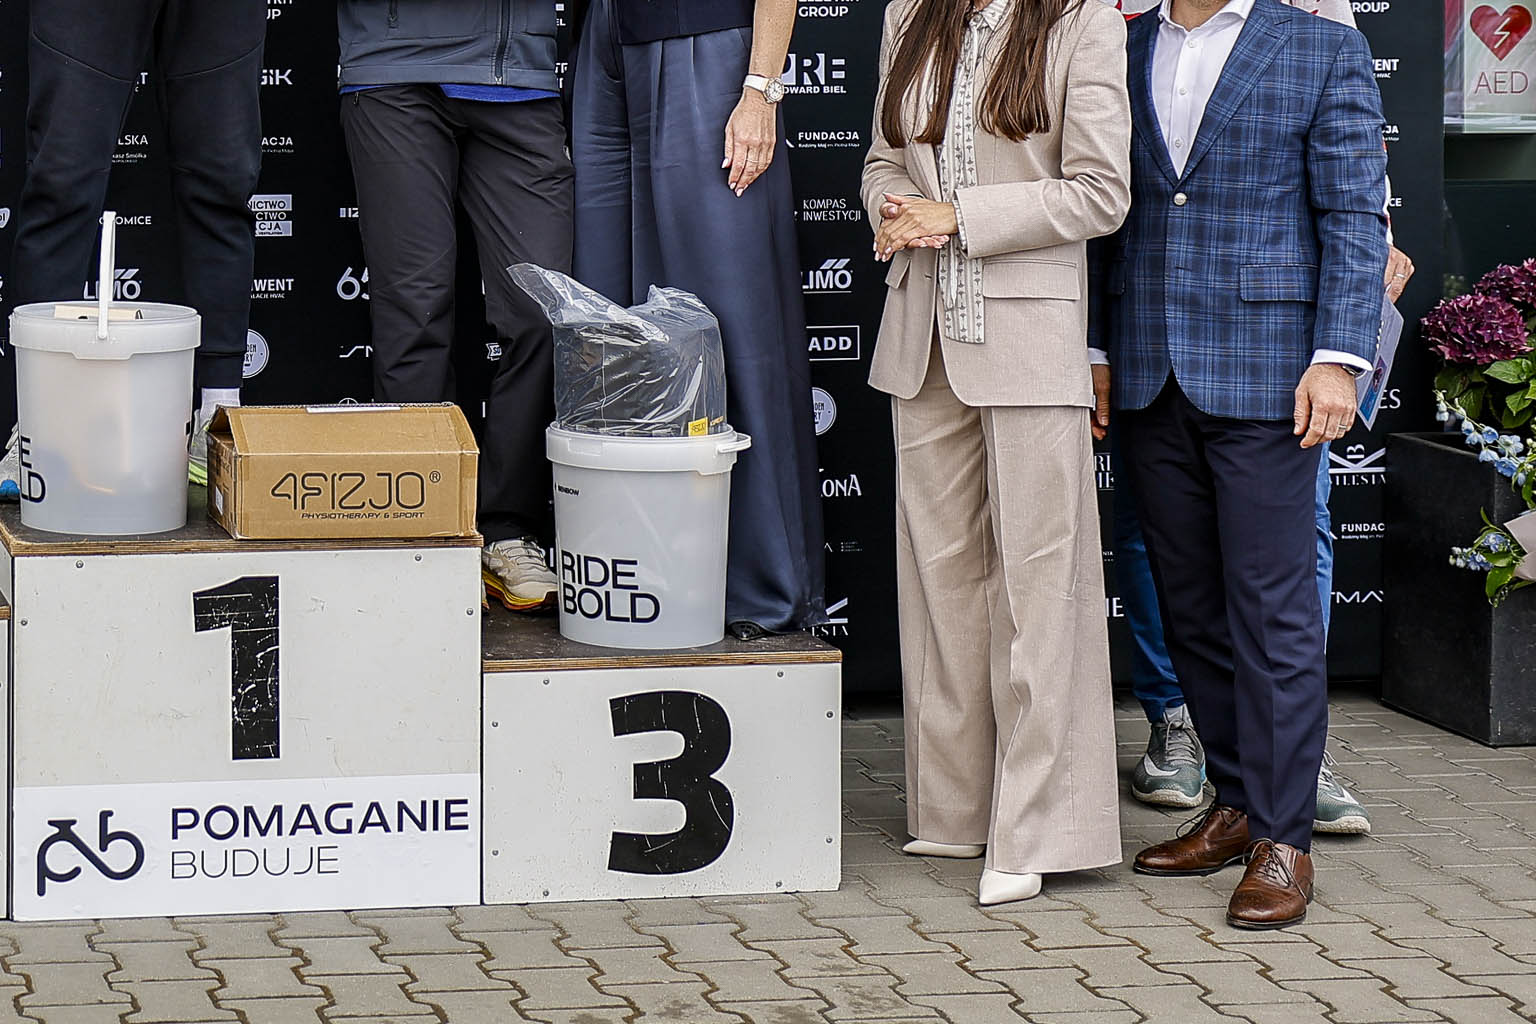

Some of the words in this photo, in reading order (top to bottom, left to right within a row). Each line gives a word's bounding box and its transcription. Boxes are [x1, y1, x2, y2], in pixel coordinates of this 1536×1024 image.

[798, 6, 849, 18] GROUP
[823, 85, 847, 94] BIEL
[1474, 70, 1529, 96] AED
[798, 131, 860, 141] FUNDACJA
[803, 198, 847, 210] KOMPAS
[803, 210, 861, 222] INWESTYCJI
[301, 512, 381, 520] PHYSIOTHERAPY
[392, 511, 425, 519] SPORT
[561, 549, 640, 591] RIDE
[563, 582, 661, 624] BOLD
[194, 574, 281, 761] 1
[607, 689, 735, 875] 3
[171, 798, 469, 841] POMAGANIE
[171, 845, 339, 880] BUDUJE
